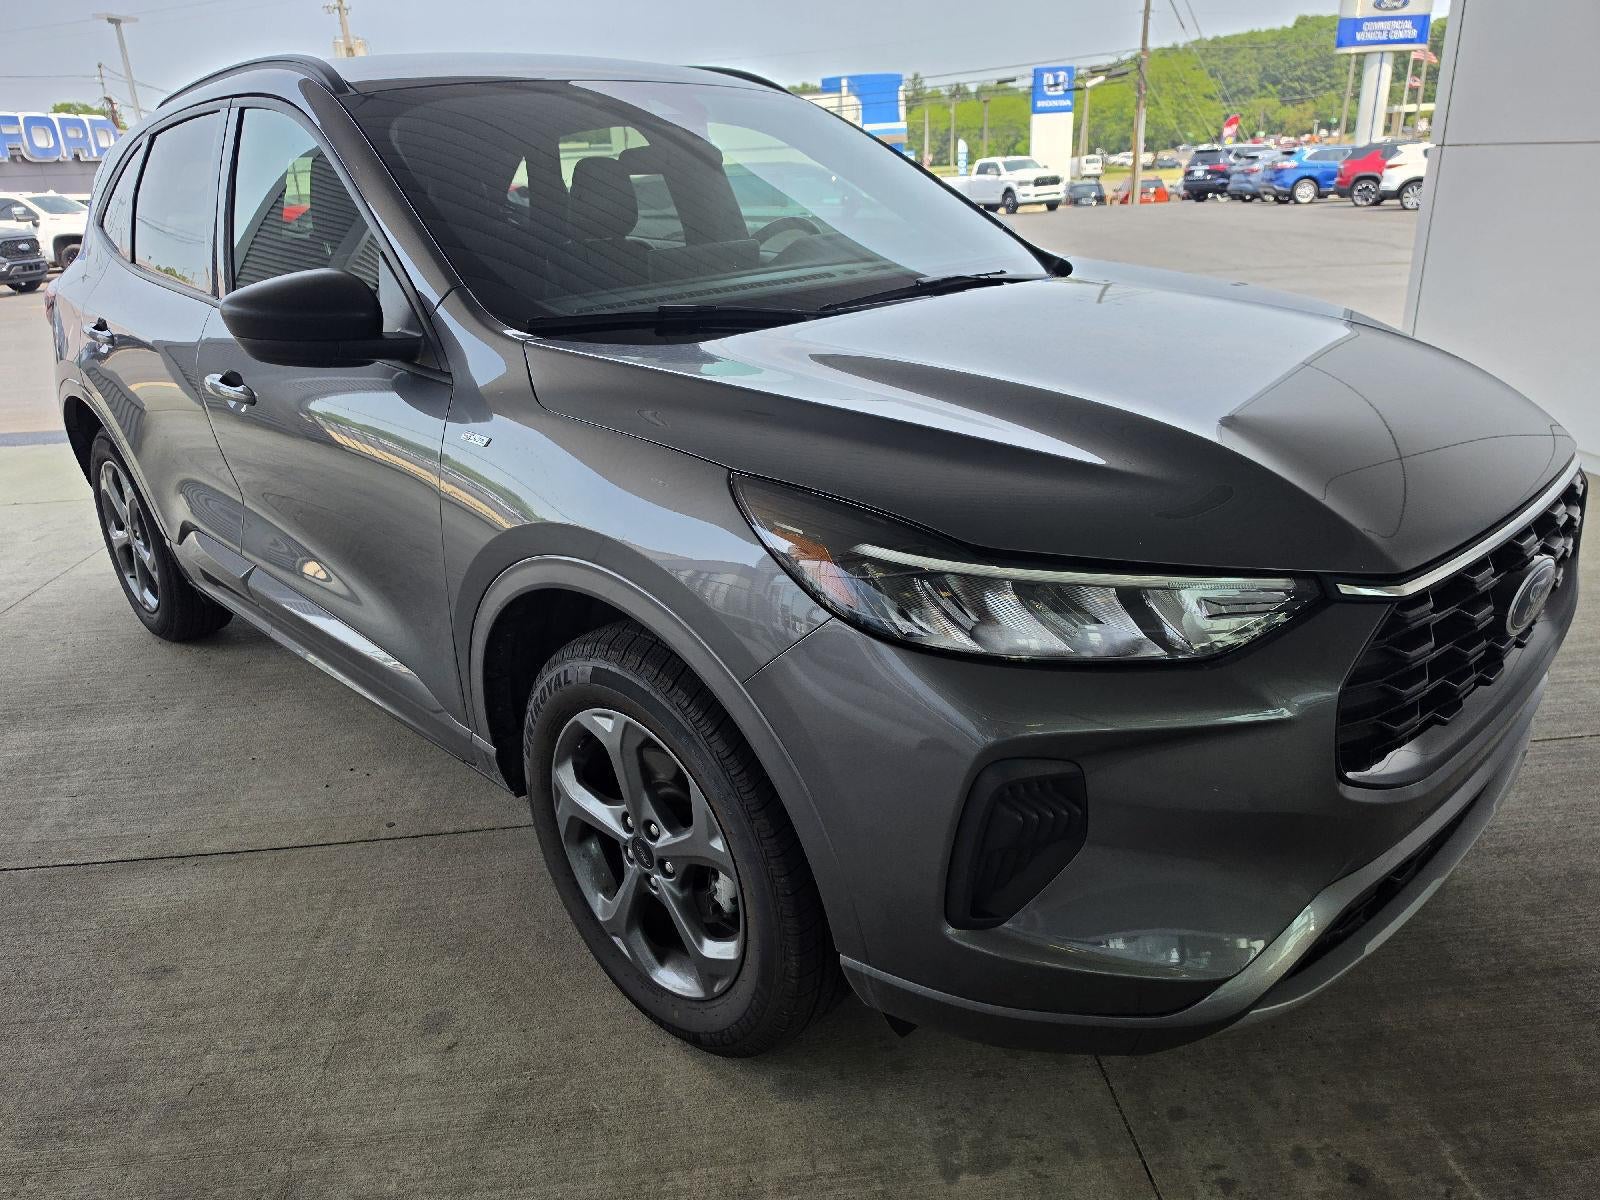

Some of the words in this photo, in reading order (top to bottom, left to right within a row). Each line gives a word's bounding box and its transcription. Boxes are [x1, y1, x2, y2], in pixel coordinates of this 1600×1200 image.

[1362, 20, 1413, 31] COMMERCIAL
[1355, 31, 1388, 41] VEHICLE
[1388, 29, 1418, 39] CENTER
[0, 113, 119, 161] FORD
